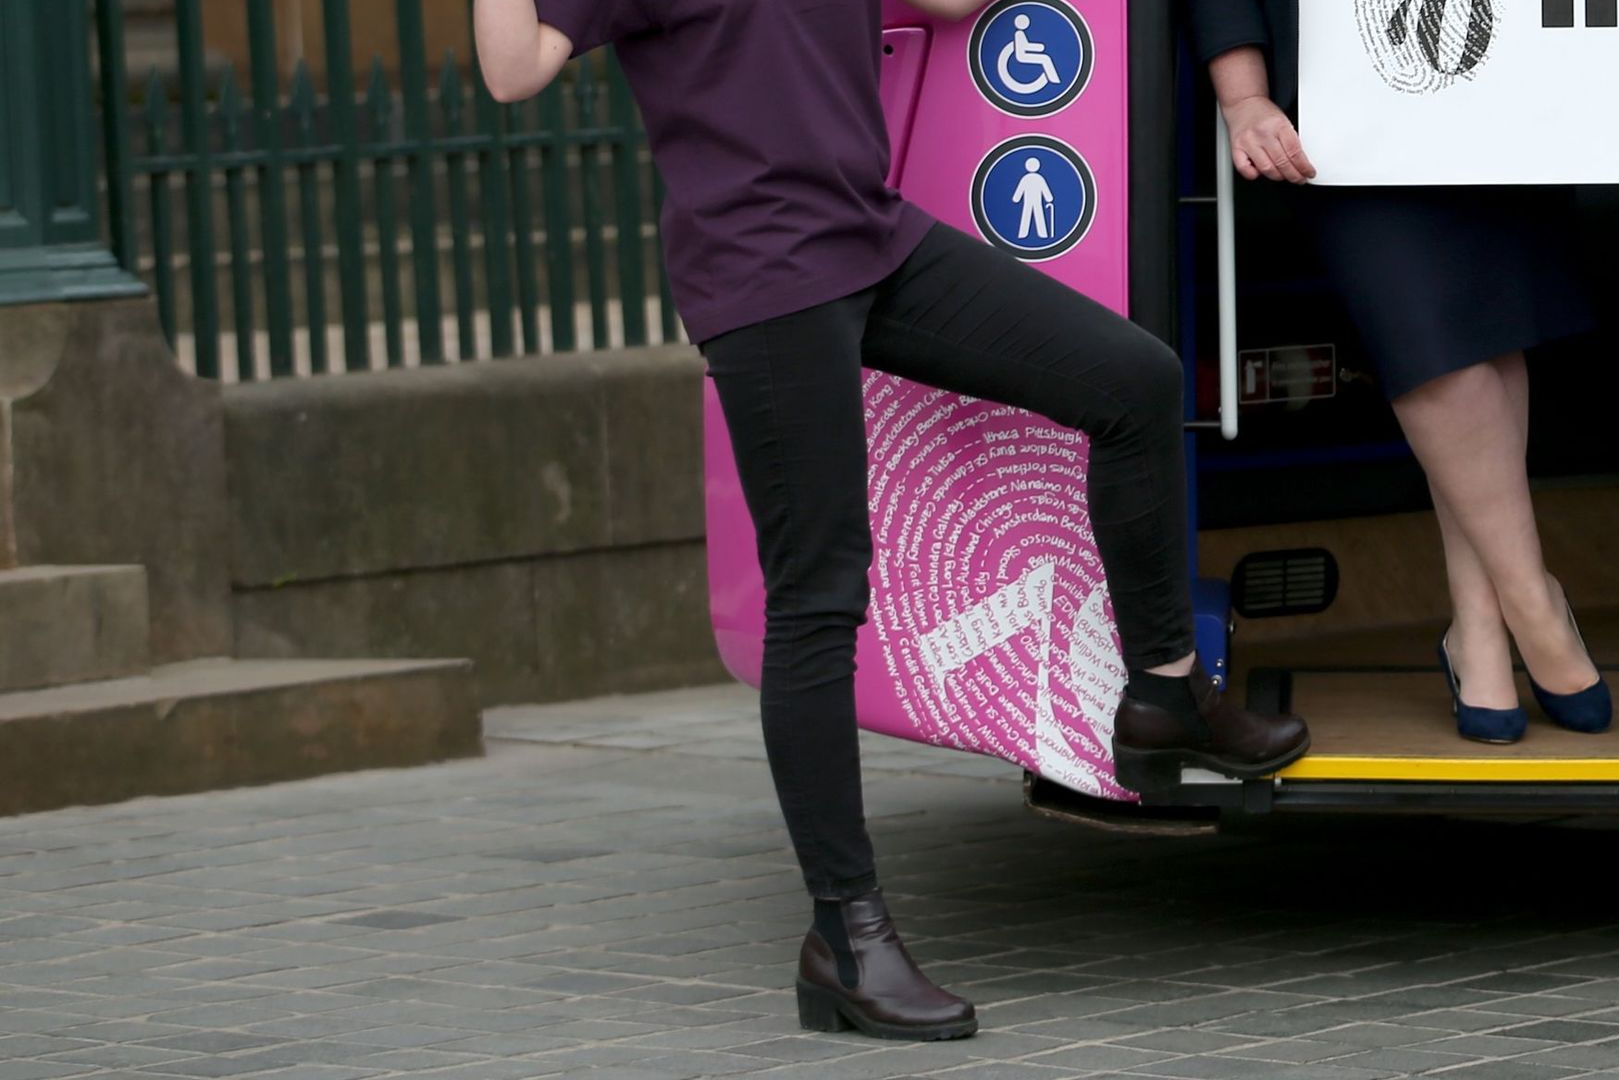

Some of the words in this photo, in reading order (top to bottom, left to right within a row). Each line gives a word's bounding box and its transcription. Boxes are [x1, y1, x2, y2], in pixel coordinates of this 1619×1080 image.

[869, 384, 893, 408] Kong
[874, 401, 925, 461] Charlottetown
[947, 411, 989, 435] Orleans
[983, 428, 1020, 444] Ithaca
[1025, 426, 1082, 445] Pittsburgh
[868, 469, 890, 513] Boulder
[916, 402, 958, 435] Brooklyn
[909, 433, 948, 469] Scranton
[927, 452, 955, 476] Tulsa
[989, 445, 1017, 458] Bury
[1020, 444, 1077, 461] Bangalore
[933, 460, 975, 502] Edmunds
[997, 462, 1046, 479] Portland
[1011, 477, 1061, 493] Nanaimo
[1029, 491, 1065, 510] Vegas
[1067, 503, 1088, 521] Las
[1064, 484, 1088, 504] Nas
[907, 502, 936, 560] Canterbury
[933, 499, 964, 539] Galway
[993, 508, 1059, 538] Amsterdam
[1060, 515, 1098, 547] Berksh
[943, 523, 964, 557] Island
[957, 532, 980, 585] Auckland
[976, 502, 1013, 533] Chicago
[1020, 533, 1077, 555] Francisco
[927, 542, 942, 601] Caloundra
[996, 545, 1021, 579] Stroud
[1028, 552, 1057, 567] Bath
[1078, 546, 1100, 567] San
[909, 564, 922, 587] Fort
[942, 560, 956, 588] Long
[975, 571, 990, 593] City
[1058, 556, 1111, 599] Melbourne
[870, 586, 890, 641] Annapolis
[883, 592, 903, 630] Austin
[900, 593, 921, 648] Guildford
[913, 589, 928, 627] Wayne
[1005, 609, 1024, 636] York
[1053, 595, 1115, 652] EDINBURGH
[1056, 621, 1099, 666] Wellington
[883, 643, 900, 677] Marie
[1050, 643, 1086, 678] Windsor
[900, 637, 920, 675] Cardiff
[913, 675, 951, 735] Gothenburg
[966, 679, 988, 707] Louis
[975, 668, 1000, 696] Delft
[901, 698, 921, 728] Sault
[985, 705, 999, 719] St
[998, 694, 1037, 735] Brisbane
[997, 717, 1019, 740] Cruz
